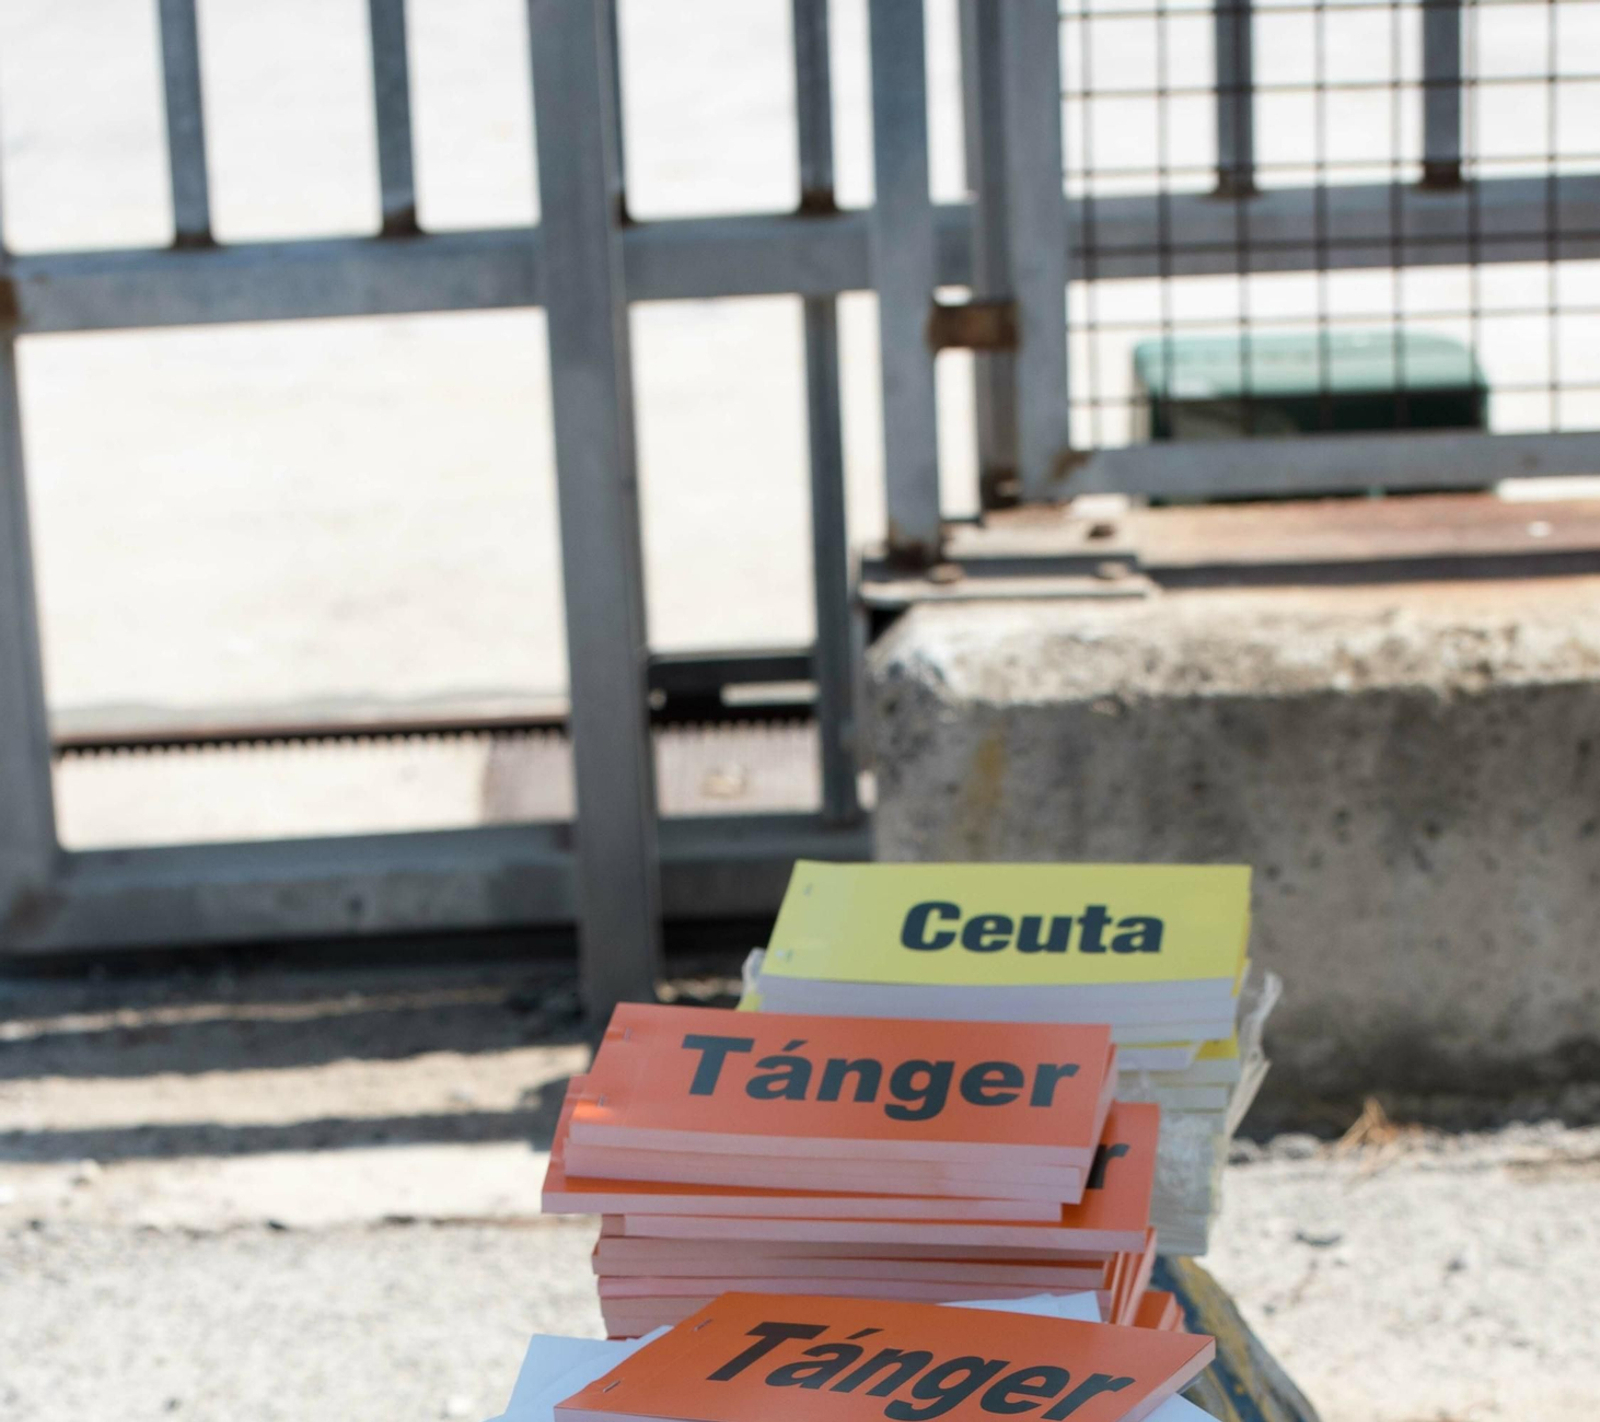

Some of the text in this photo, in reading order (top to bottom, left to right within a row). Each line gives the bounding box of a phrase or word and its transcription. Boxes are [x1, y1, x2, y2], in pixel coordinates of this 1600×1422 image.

[900, 901, 1164, 954] Ceuta
[681, 1034, 1080, 1121] Tánger
[706, 1321, 1136, 1422] Tánger
